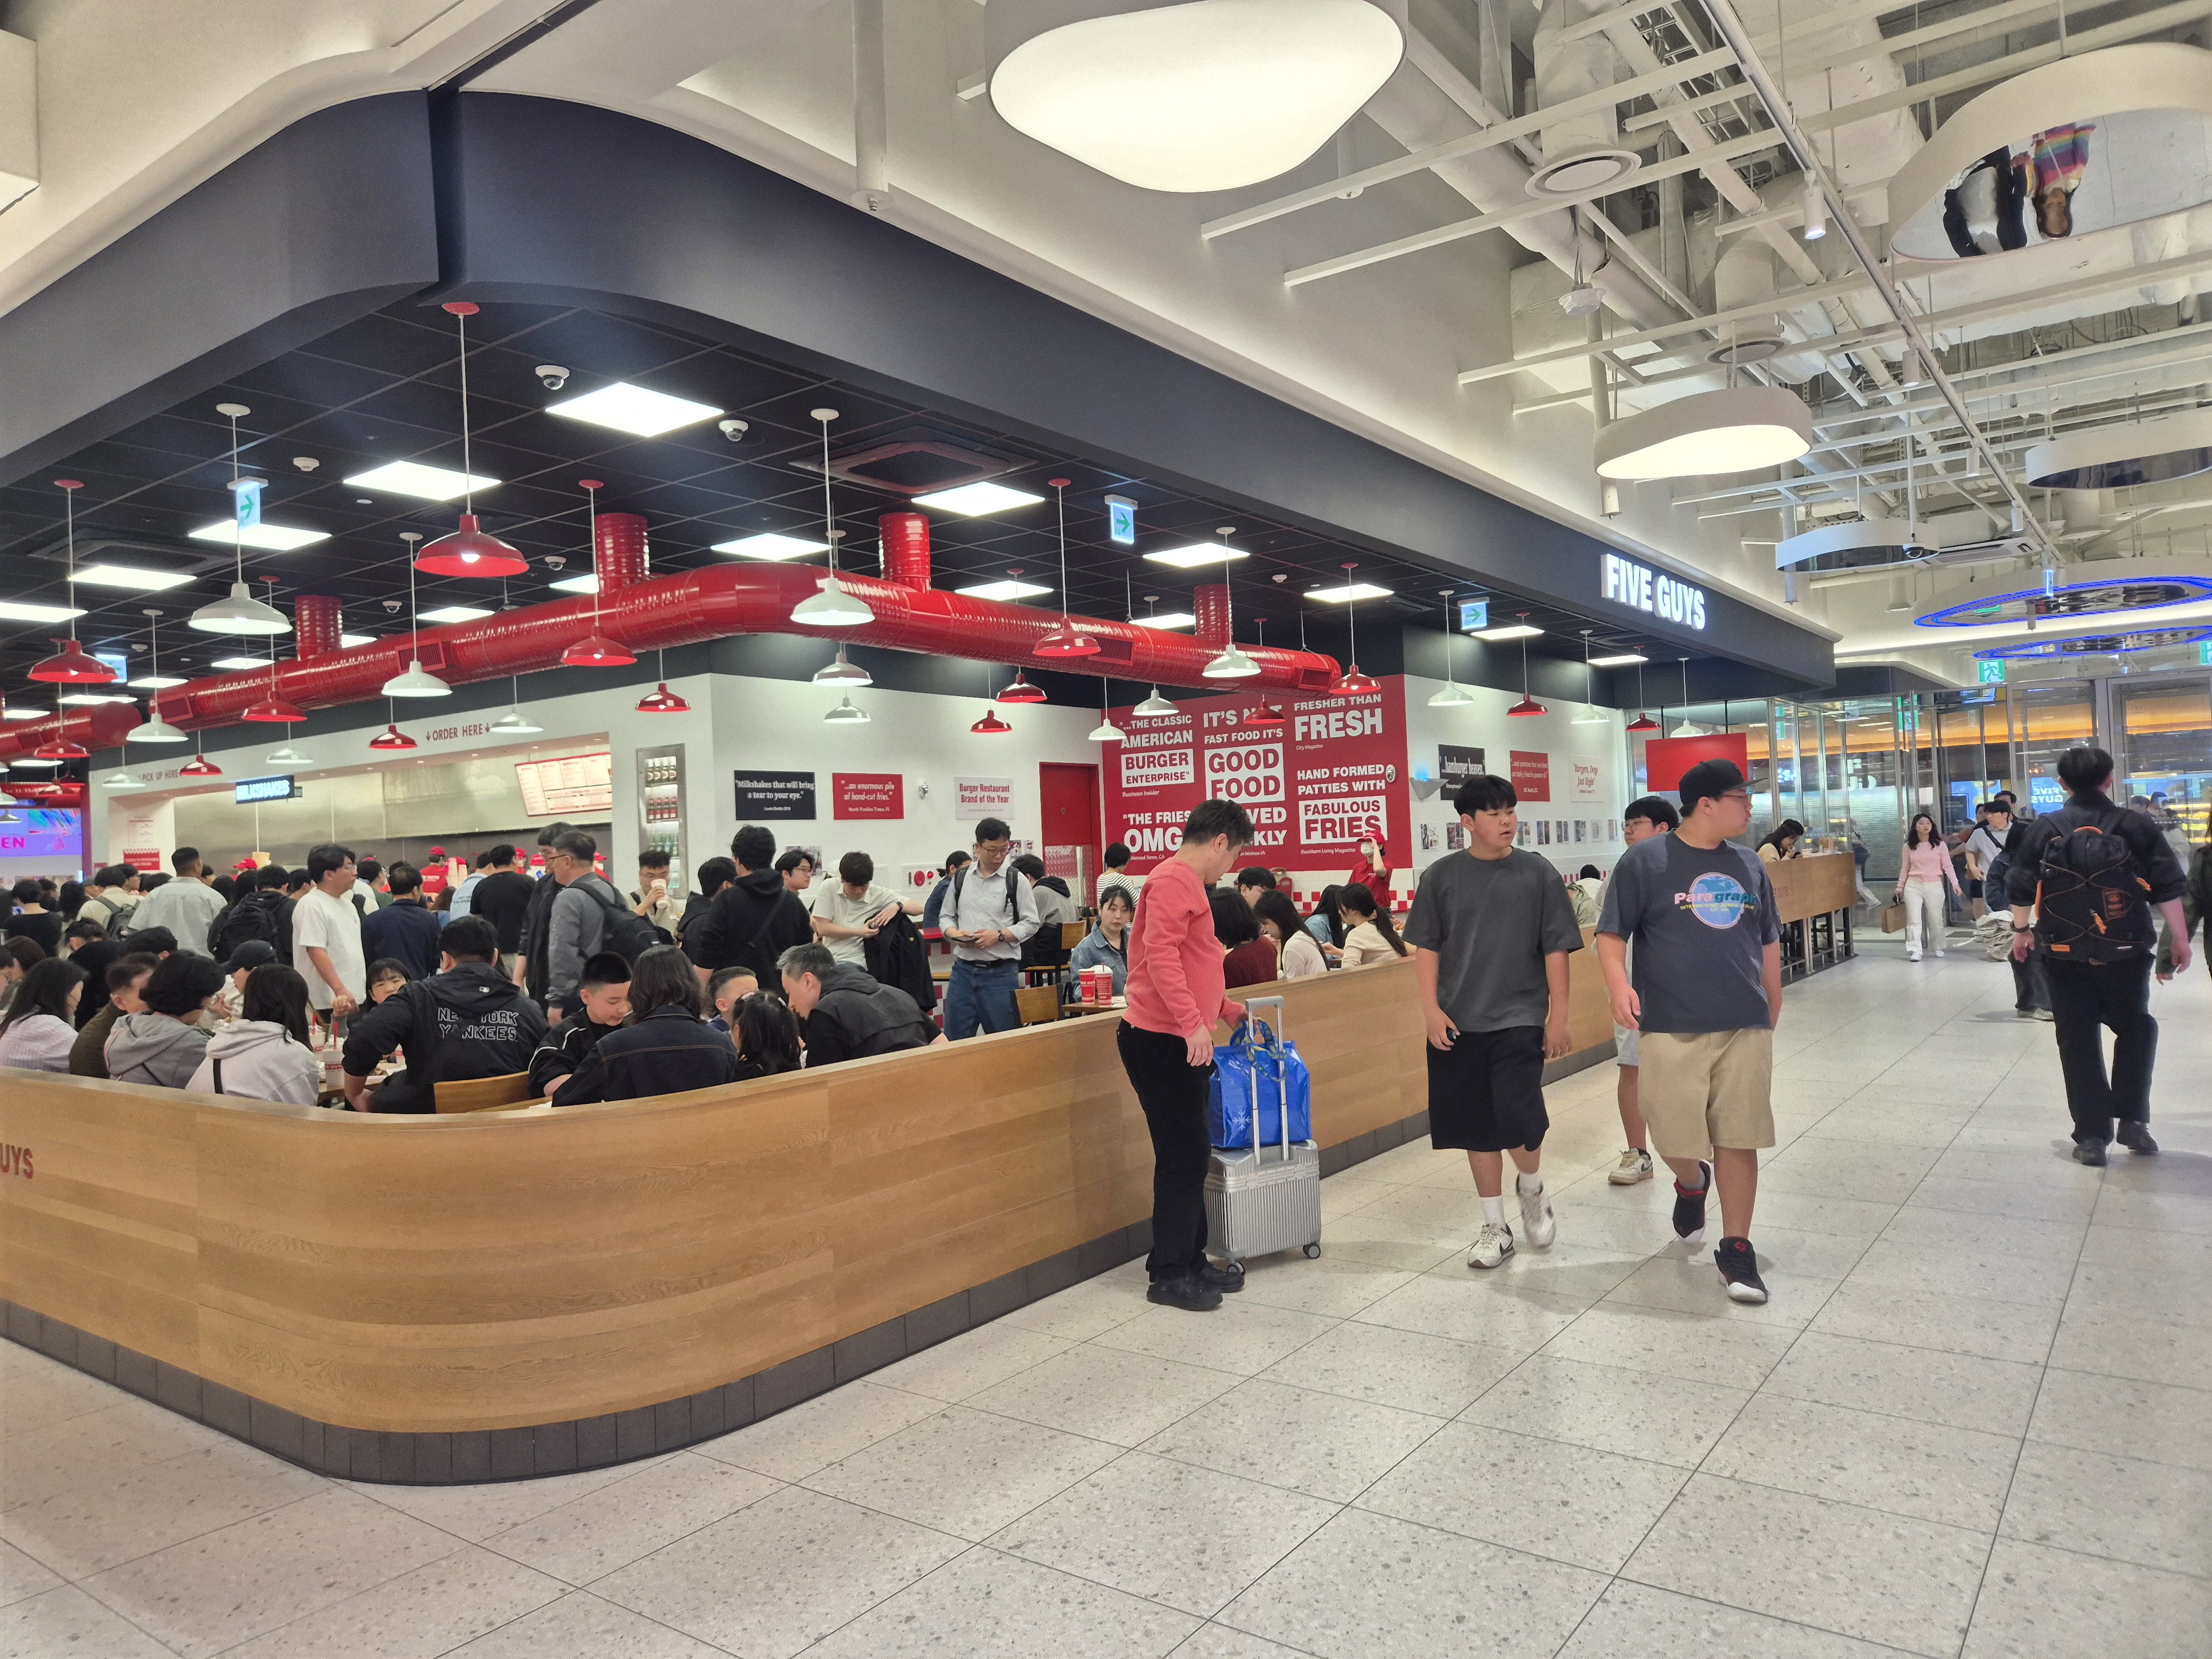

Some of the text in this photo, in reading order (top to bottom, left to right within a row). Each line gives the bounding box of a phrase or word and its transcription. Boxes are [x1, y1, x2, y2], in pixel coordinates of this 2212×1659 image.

[1601, 554, 1705, 629] FIVE GUYS
[1294, 694, 1381, 711] FRESHER THAN
[1152, 714, 1192, 727] CLASSIC
[1203, 705, 1282, 728] IT'S NT
[1295, 708, 1383, 741] FRESH
[432, 723, 483, 740] ORDER HERE
[1120, 730, 1193, 749] AMERICAN
[1204, 728, 1283, 744] FAST FOOD IT'S
[1126, 752, 1189, 770] BURGER
[1209, 748, 1280, 773] GOOD
[156, 771, 162, 780] UP
[165, 769, 178, 779] HERE
[1126, 771, 1190, 784] ENTERPRISE"
[1297, 764, 1385, 780] HAND FORMED
[773, 780, 786, 789] that
[799, 781, 815, 790] bring
[885, 781, 895, 791] pile
[959, 783, 1010, 794] Burger Restaurant
[1211, 775, 1280, 799] FOOD
[1298, 780, 1385, 795] PATTIES WITH
[775, 792, 789, 801] your
[844, 791, 851, 800] of
[852, 791, 875, 800] hand-cut
[961, 794, 978, 802] Brand
[987, 795, 995, 803] the
[997, 795, 1009, 803] Year
[1245, 807, 1287, 824] VED
[1305, 800, 1380, 816] FABULOUS
[1156, 810, 1191, 823] FRIES
[1305, 815, 1381, 839] FRIES
[2, 837, 24, 849] EN
[1124, 826, 1183, 853] OMG
[1674, 892, 1756, 904] Paragraph
[438, 1007, 519, 1026] NE YORK
[439, 1024, 517, 1041] YNKEES
[0, 1143, 34, 1179] UYS
